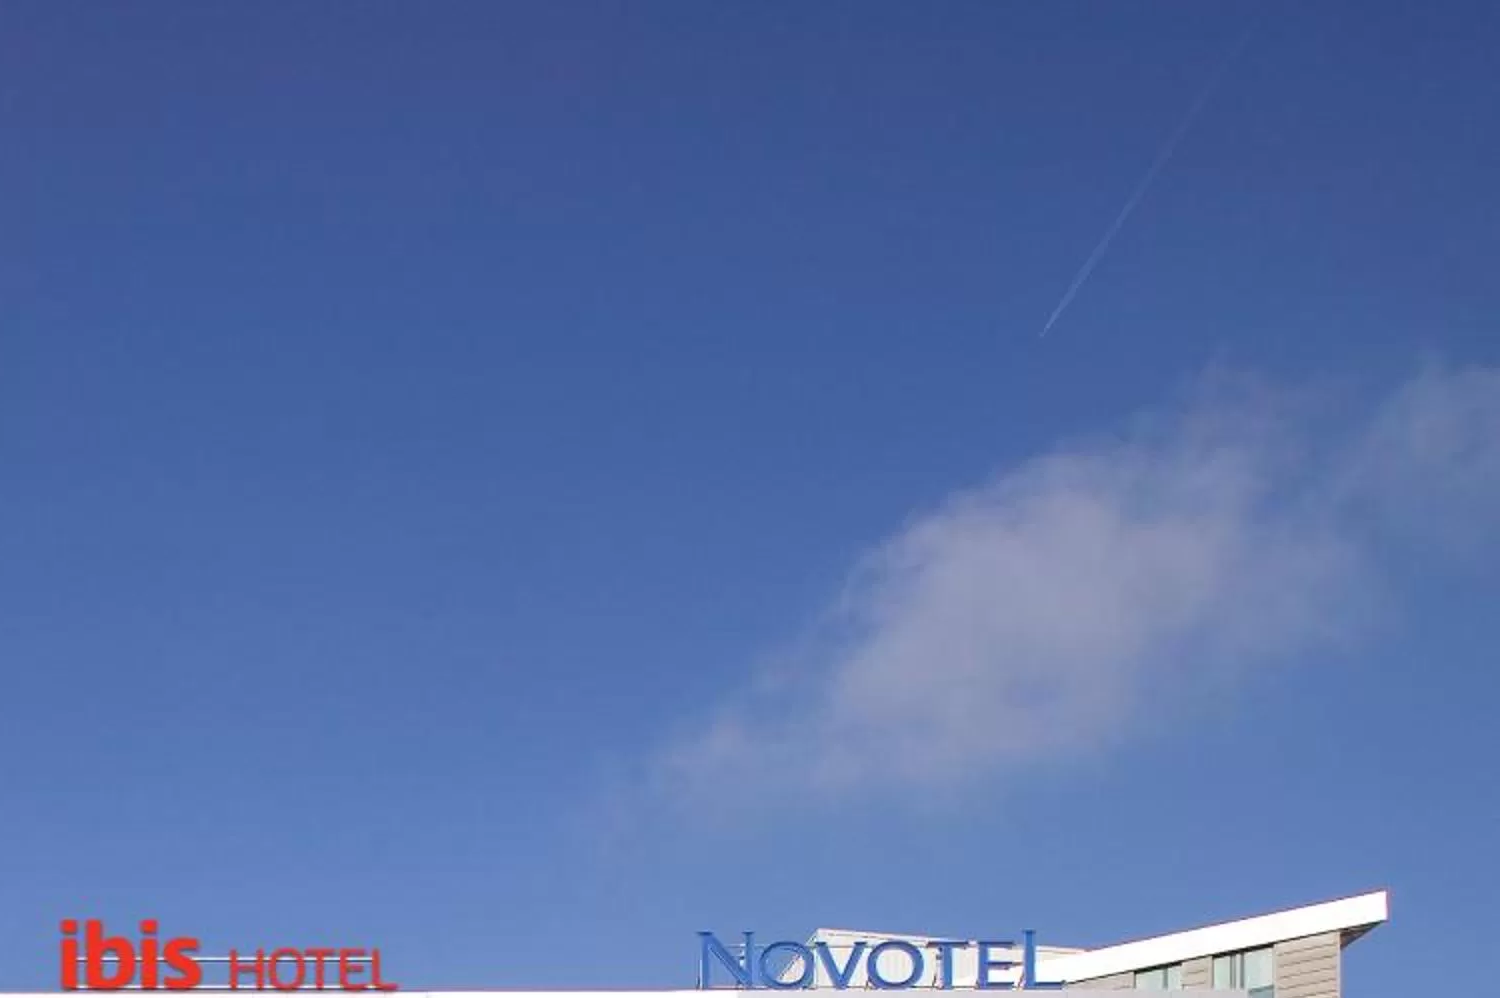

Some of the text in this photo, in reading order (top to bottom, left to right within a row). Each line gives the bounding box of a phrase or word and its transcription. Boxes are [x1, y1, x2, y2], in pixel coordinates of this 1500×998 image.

[58, 918, 399, 992] ibis HOTEL
[696, 929, 1066, 990] NOVOTEL
